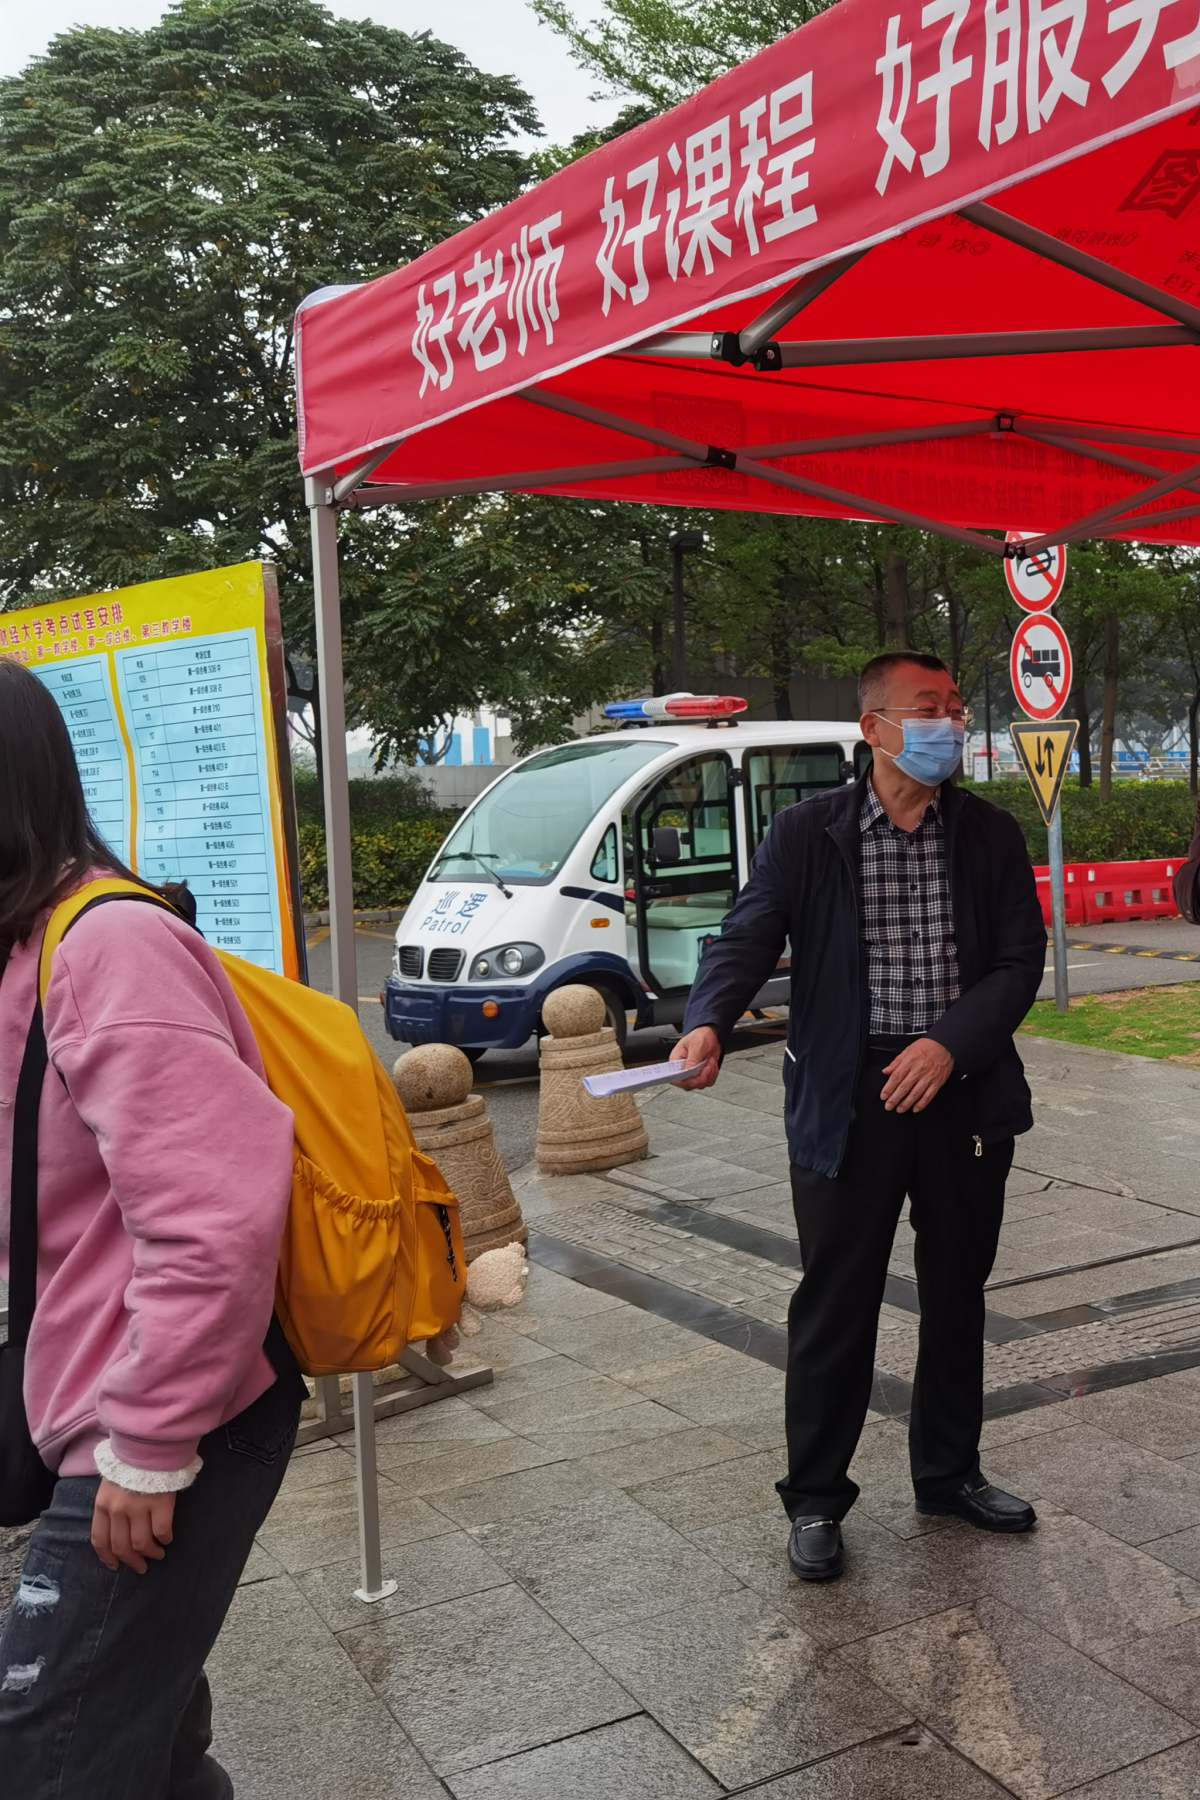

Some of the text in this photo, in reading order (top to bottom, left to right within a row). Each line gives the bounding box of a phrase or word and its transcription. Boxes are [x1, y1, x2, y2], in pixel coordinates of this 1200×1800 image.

[411, 209, 565, 400] 好老师
[595, 70, 818, 318] 好课程
[419, 916, 471, 935] Patrol
